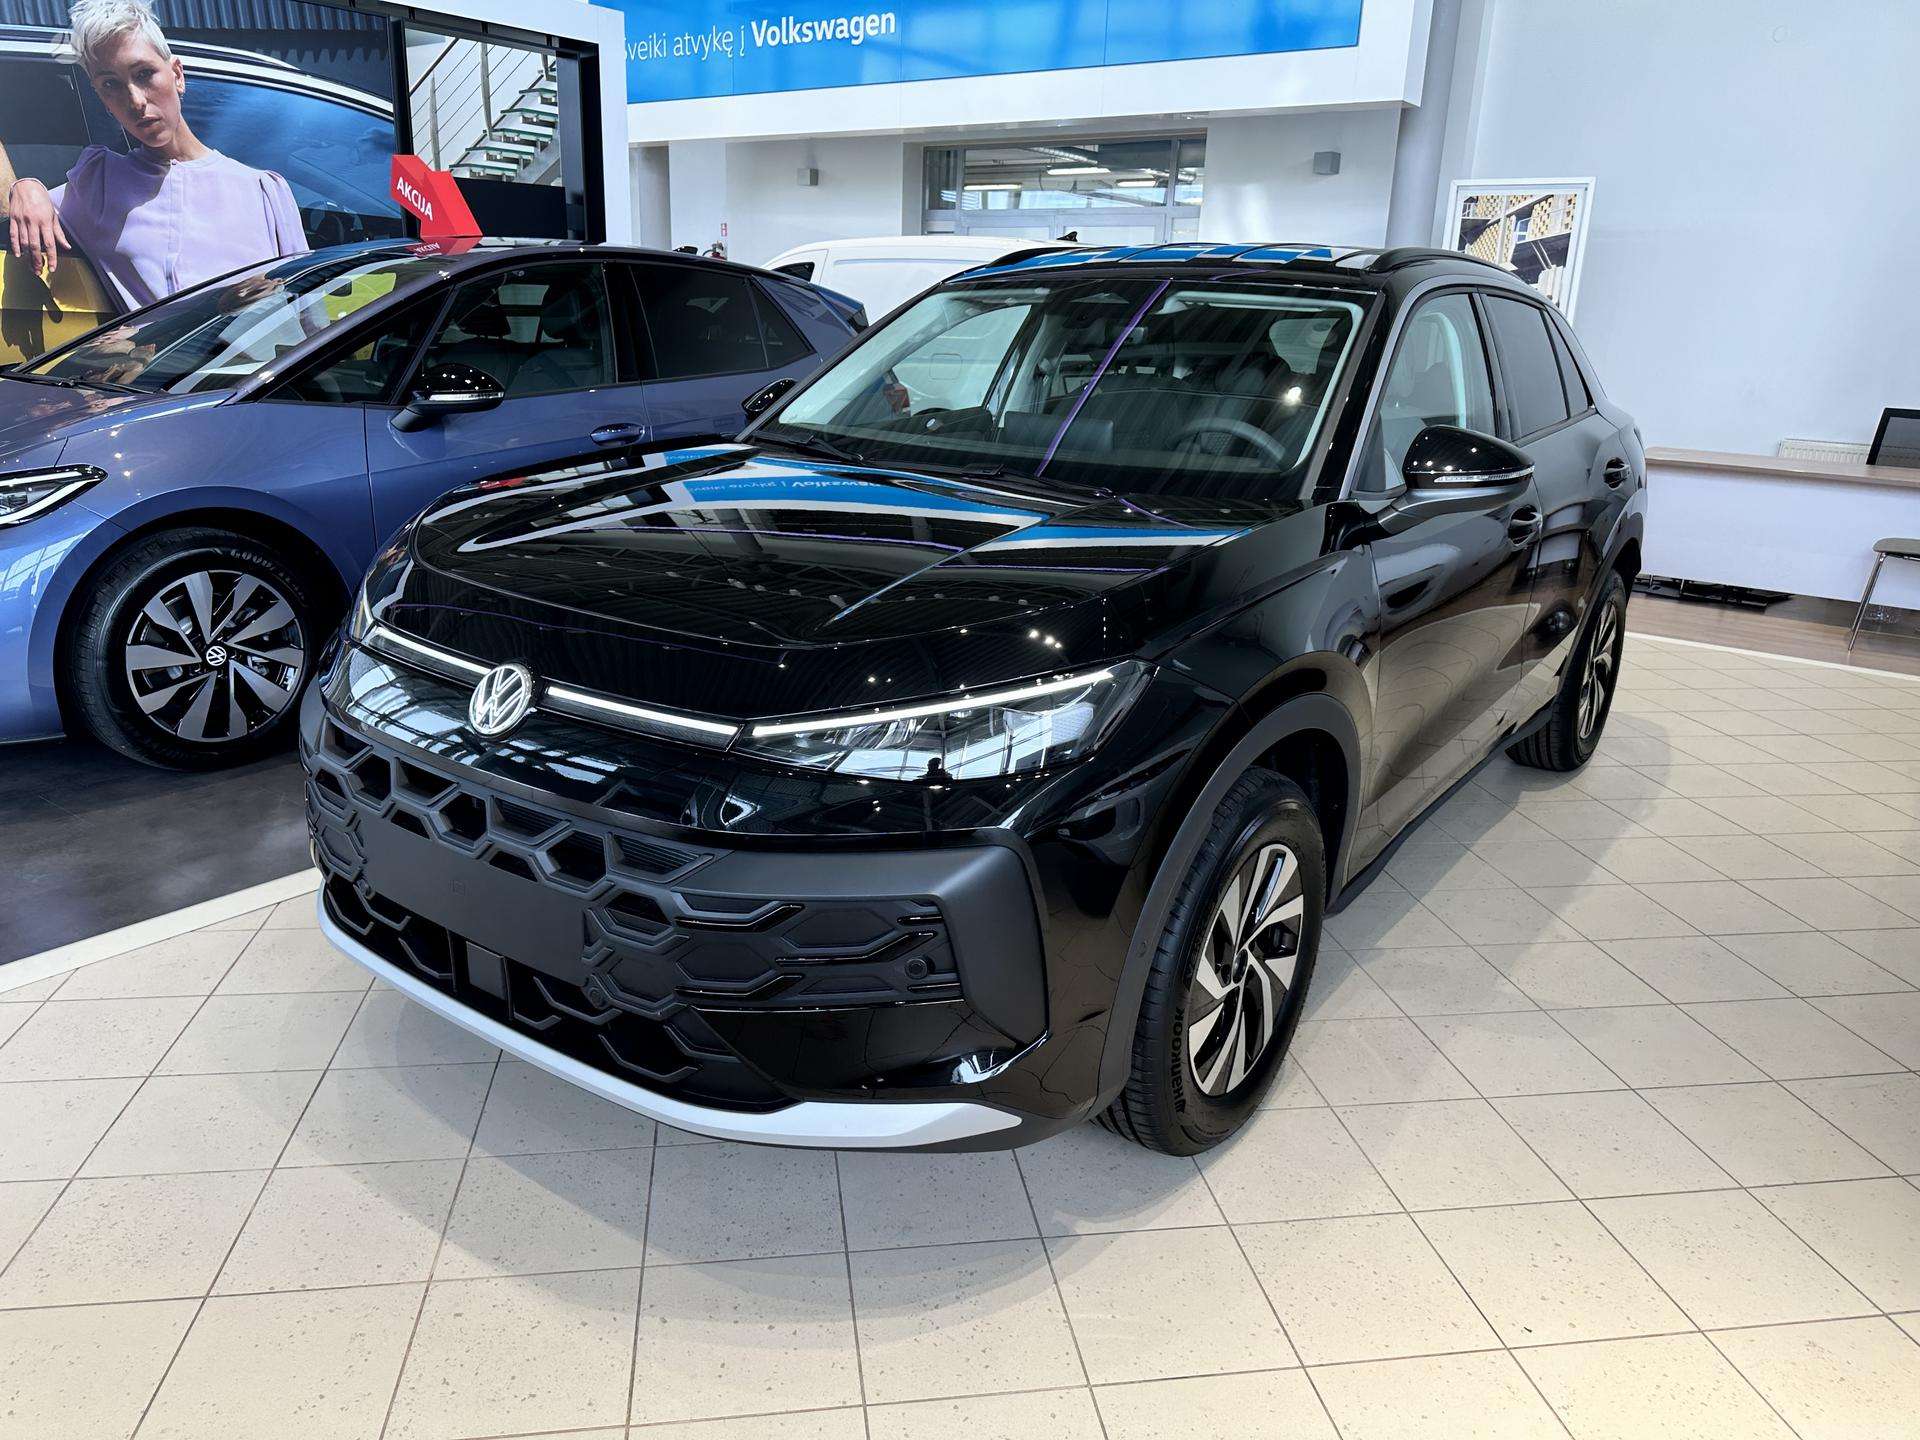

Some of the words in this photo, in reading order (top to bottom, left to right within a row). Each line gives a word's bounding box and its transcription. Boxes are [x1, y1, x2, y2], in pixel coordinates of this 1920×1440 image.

[673, 25, 733, 61] atvykę
[751, 12, 895, 47] Volkswagen
[396, 177, 433, 221] AKCIJA
[469, 663, 532, 736] VW
